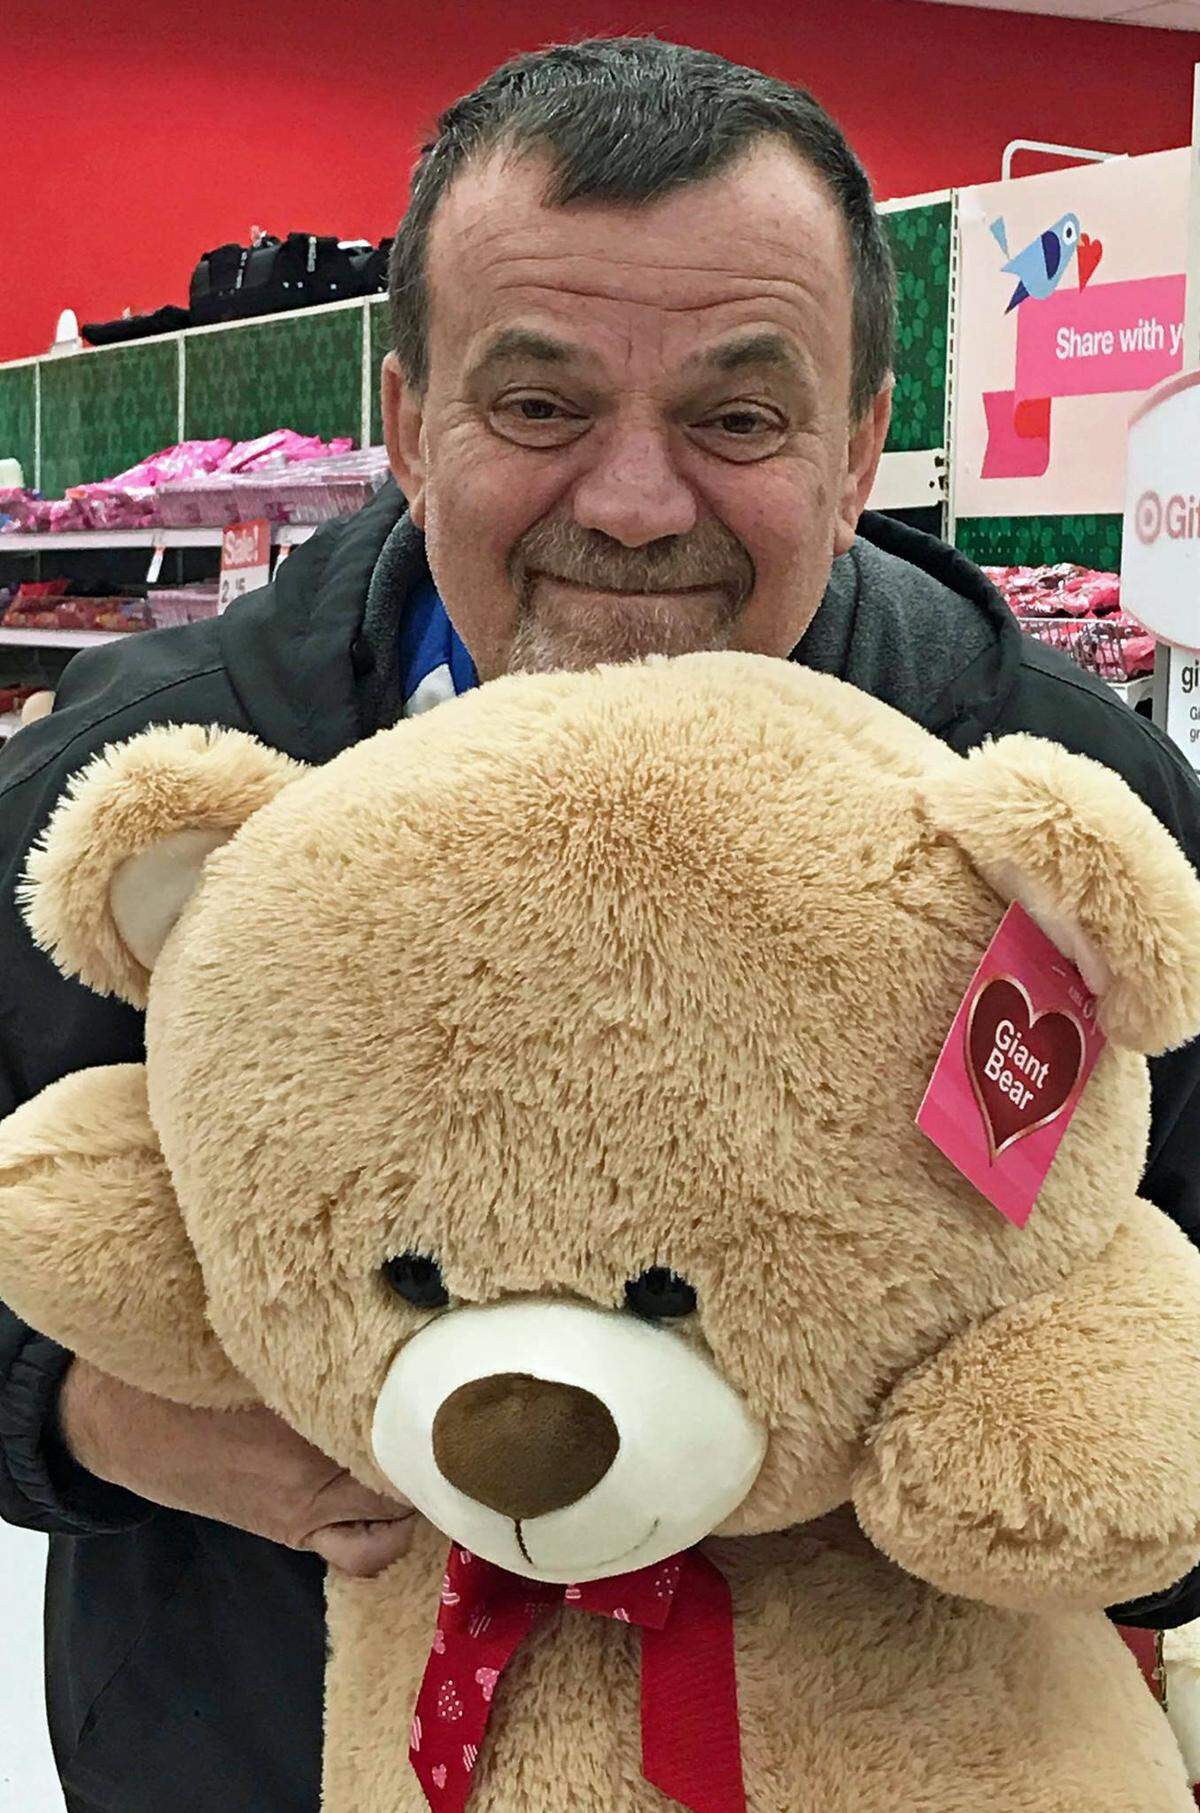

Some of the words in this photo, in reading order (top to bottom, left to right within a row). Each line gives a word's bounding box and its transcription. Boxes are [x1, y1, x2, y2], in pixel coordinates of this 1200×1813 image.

[1056, 326, 1114, 360] Share
[1119, 316, 1164, 352] with
[984, 1046, 1034, 1109] Bear
[995, 1018, 1050, 1089] Giant
